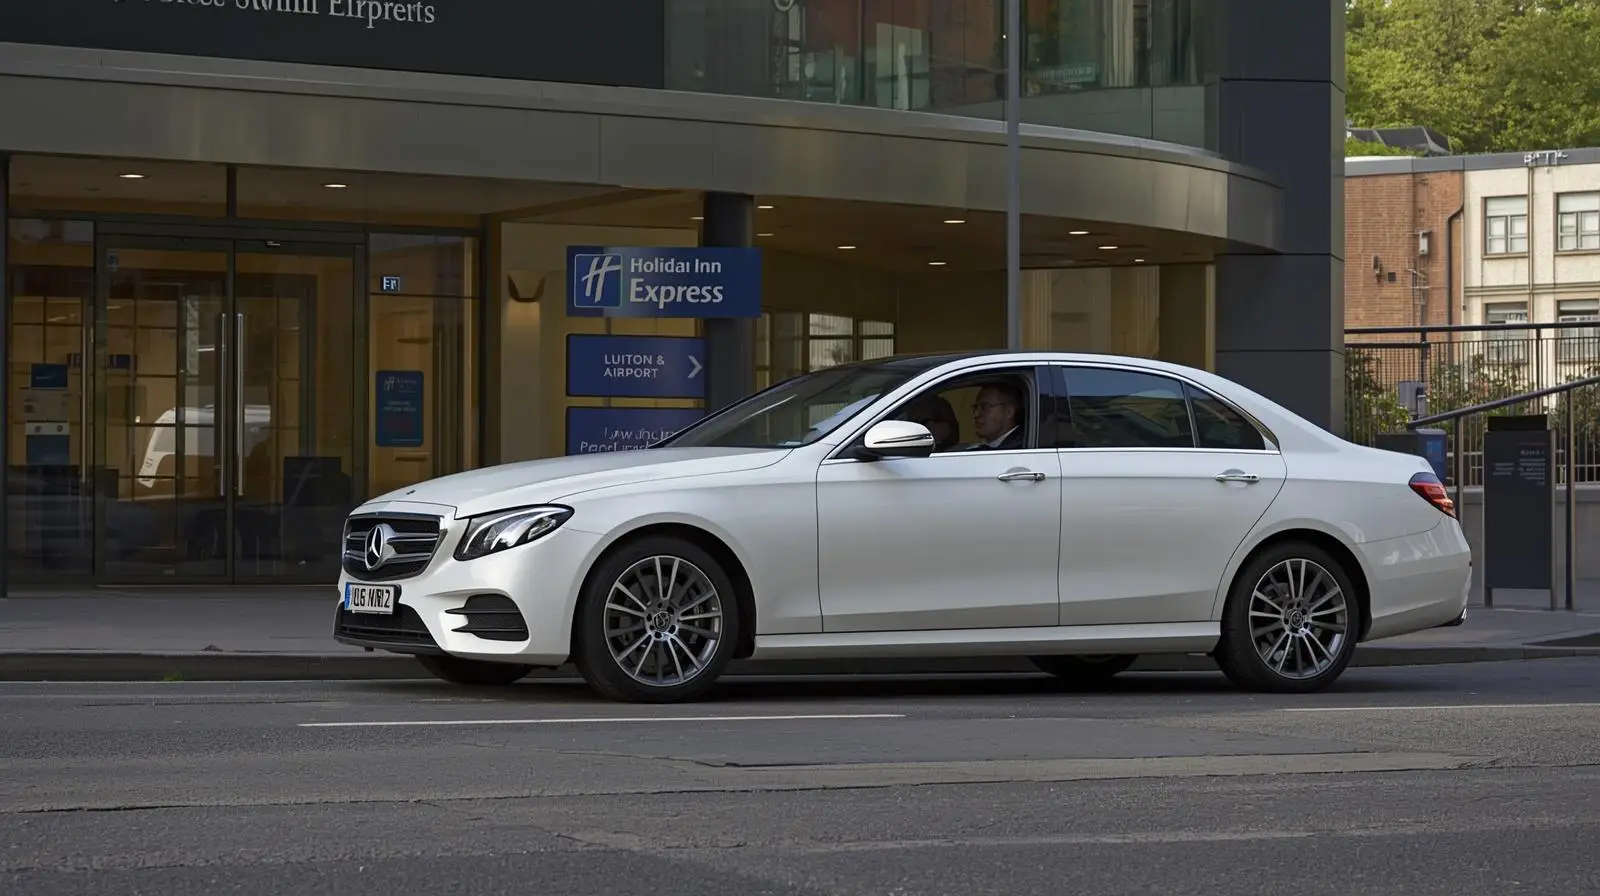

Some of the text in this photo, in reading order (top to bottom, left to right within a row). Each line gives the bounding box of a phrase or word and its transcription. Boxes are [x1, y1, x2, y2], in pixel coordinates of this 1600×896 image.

[695, 258, 722, 273] Inn
[629, 278, 724, 309] Express
[656, 355, 665, 366] &
[603, 367, 659, 379] AIRPORT
